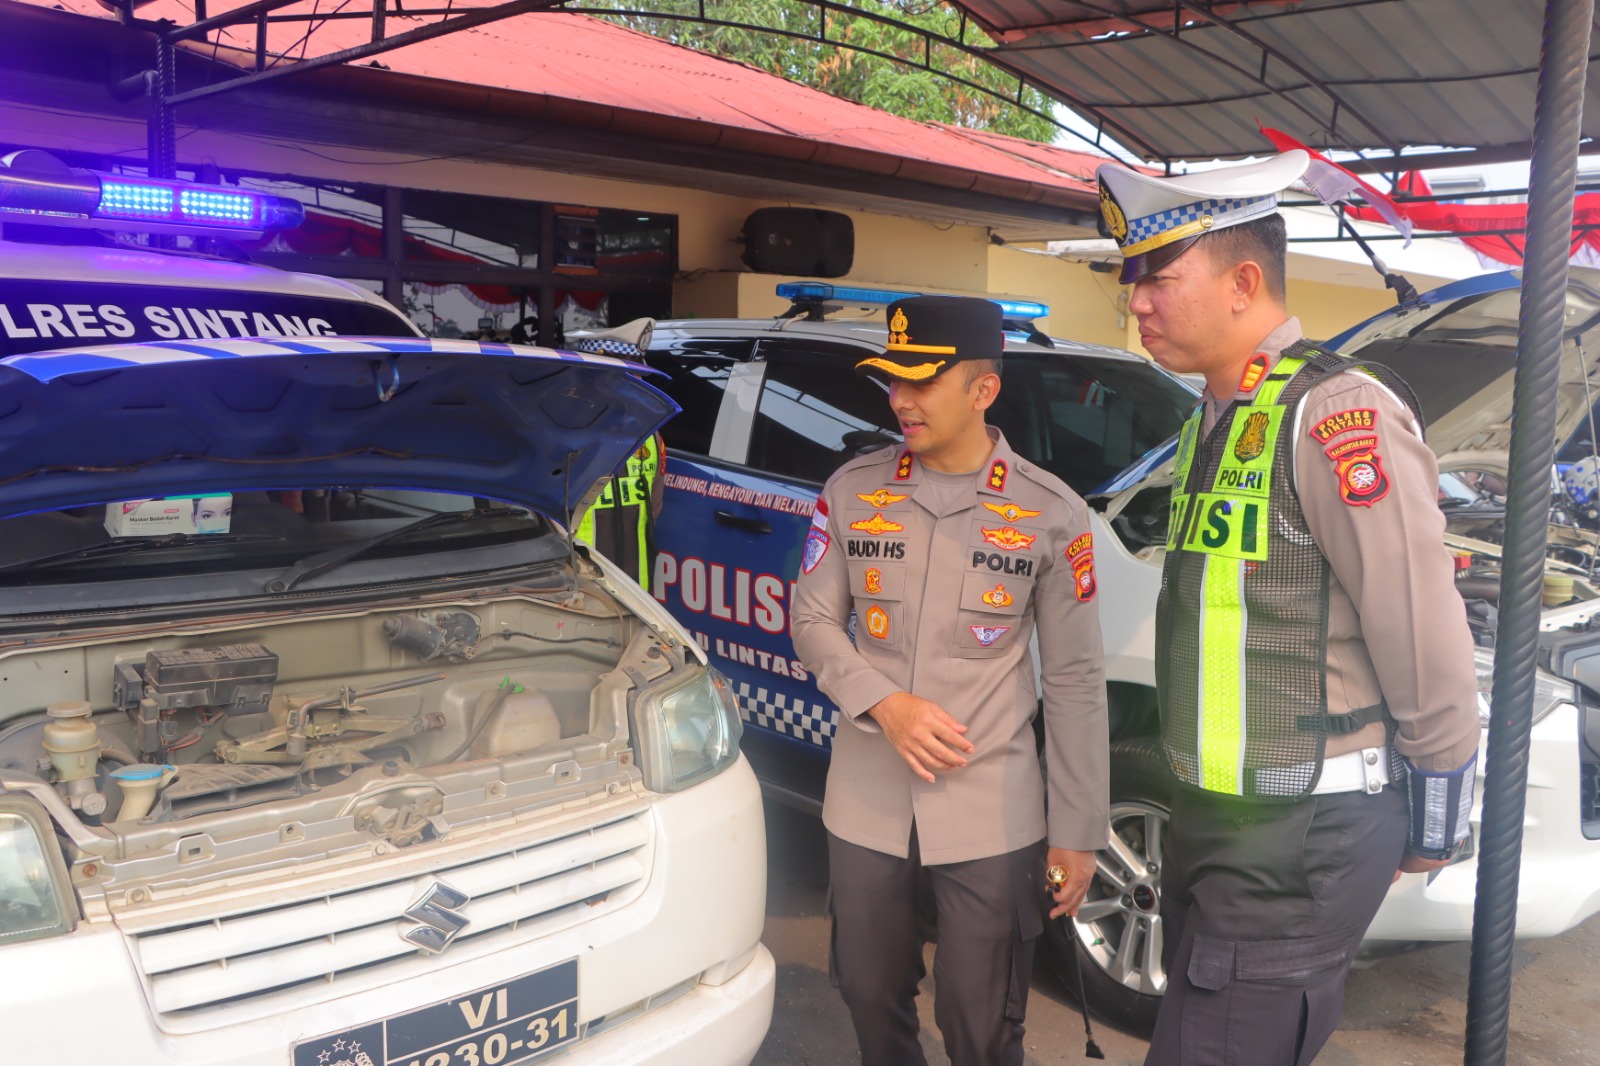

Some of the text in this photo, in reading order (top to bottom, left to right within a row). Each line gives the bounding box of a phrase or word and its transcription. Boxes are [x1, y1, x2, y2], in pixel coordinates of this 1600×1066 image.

[144, 305, 339, 340] SINTANG
[1318, 410, 1370, 434] POLRES
[1321, 417, 1372, 439] SINTANG
[1218, 469, 1264, 490] POLRI
[754, 492, 775, 509] DAN
[772, 495, 815, 517] MELAYAN
[847, 539, 906, 560] BUDI HS
[972, 550, 1034, 577] POLRI
[716, 638, 808, 682] LINTAS
[458, 987, 508, 1030] VI
